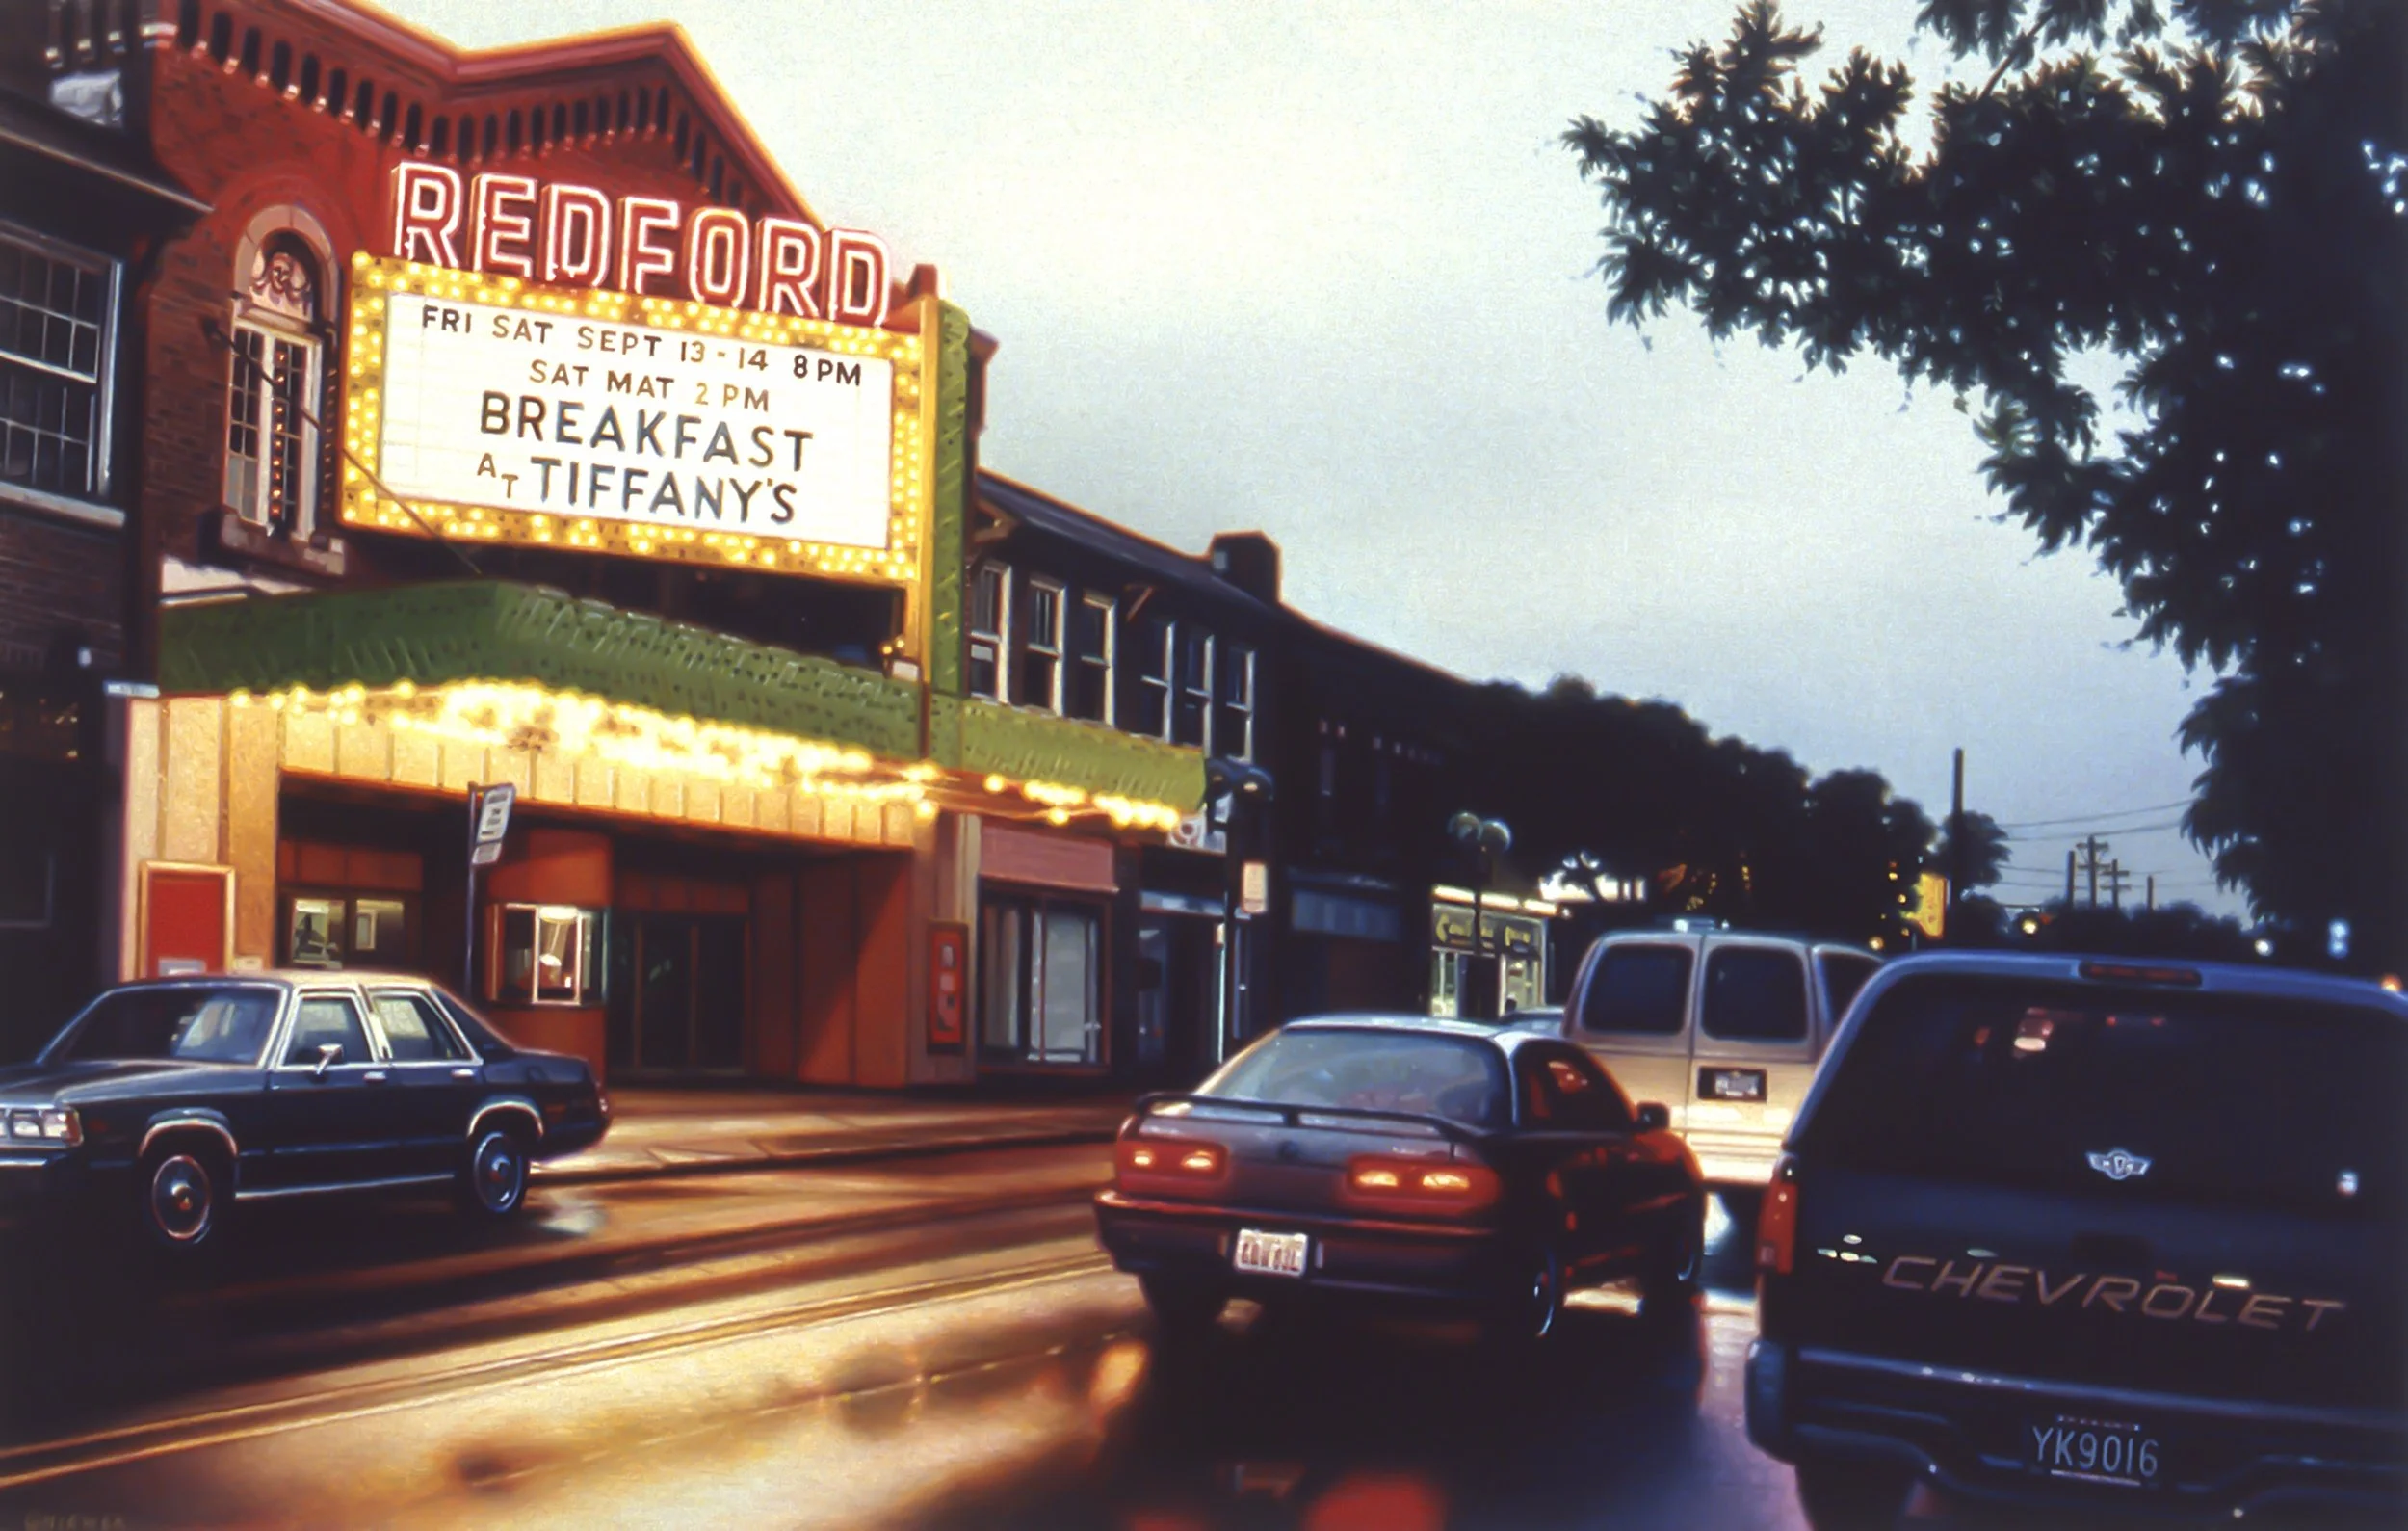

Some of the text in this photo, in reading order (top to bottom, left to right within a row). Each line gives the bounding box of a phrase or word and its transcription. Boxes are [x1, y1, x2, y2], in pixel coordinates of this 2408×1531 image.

[391, 160, 890, 329] REDFORD
[422, 304, 472, 333] FRI
[492, 314, 553, 344] SAT
[578, 326, 662, 356] SEPT
[530, 359, 589, 387] SAT
[608, 370, 674, 399] MAT
[481, 390, 813, 471] BREAKFAST
[531, 456, 797, 524] TIFFANY'S
[1882, 1255, 2346, 1331] CHEVROLET
[2032, 1425, 2159, 1478] YK9016
